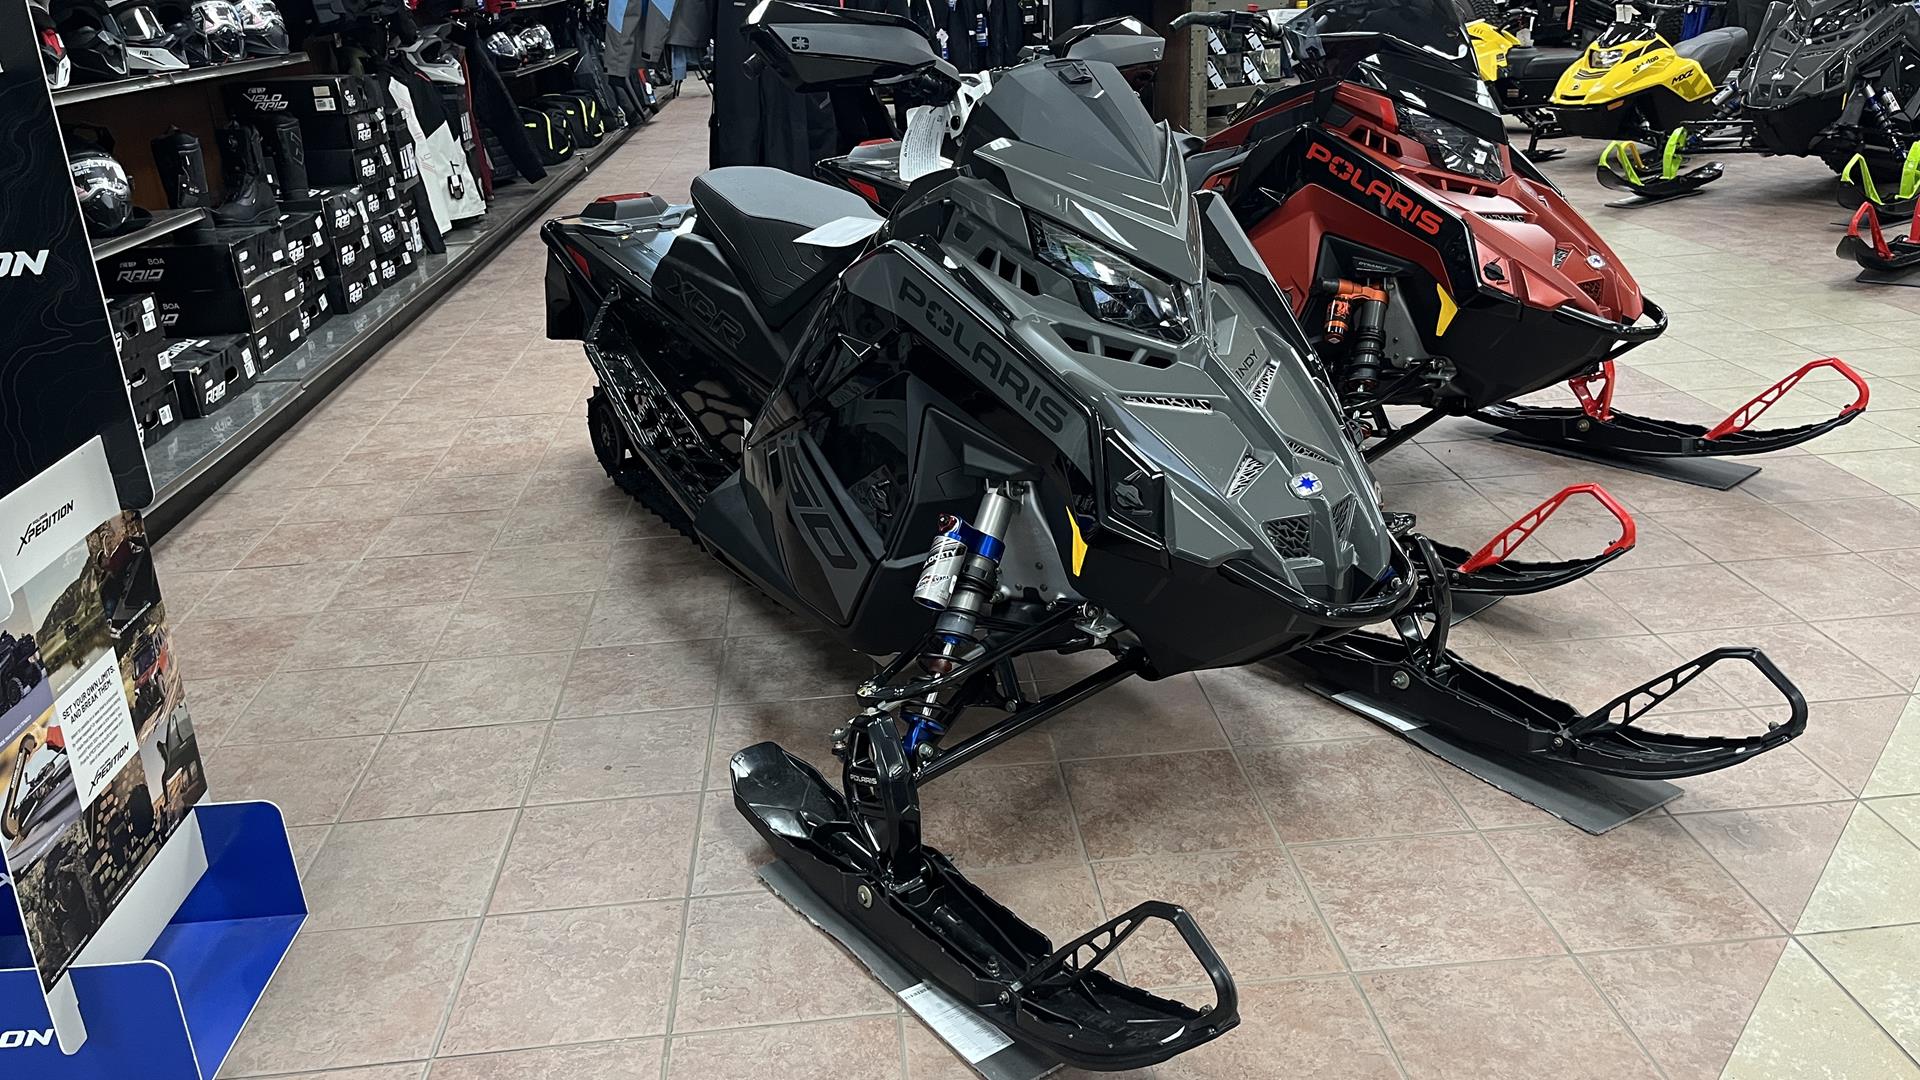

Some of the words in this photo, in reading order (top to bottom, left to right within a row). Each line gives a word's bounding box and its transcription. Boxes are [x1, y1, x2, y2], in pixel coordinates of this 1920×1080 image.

[242, 93, 283, 102] VELO
[1305, 141, 1444, 236] POLARIS
[116, 268, 165, 283] RAID
[666, 271, 747, 349] XCR
[900, 276, 1068, 434] POLARIS
[1235, 348, 1258, 379] INDY
[16, 499, 74, 556] XPEDITION
[62, 705, 73, 720] SET
[72, 691, 87, 709] YOUR
[86, 680, 99, 699] OWN
[70, 709, 82, 724] AND
[81, 694, 99, 716] BREAK
[88, 741, 130, 797] XPEDITION
